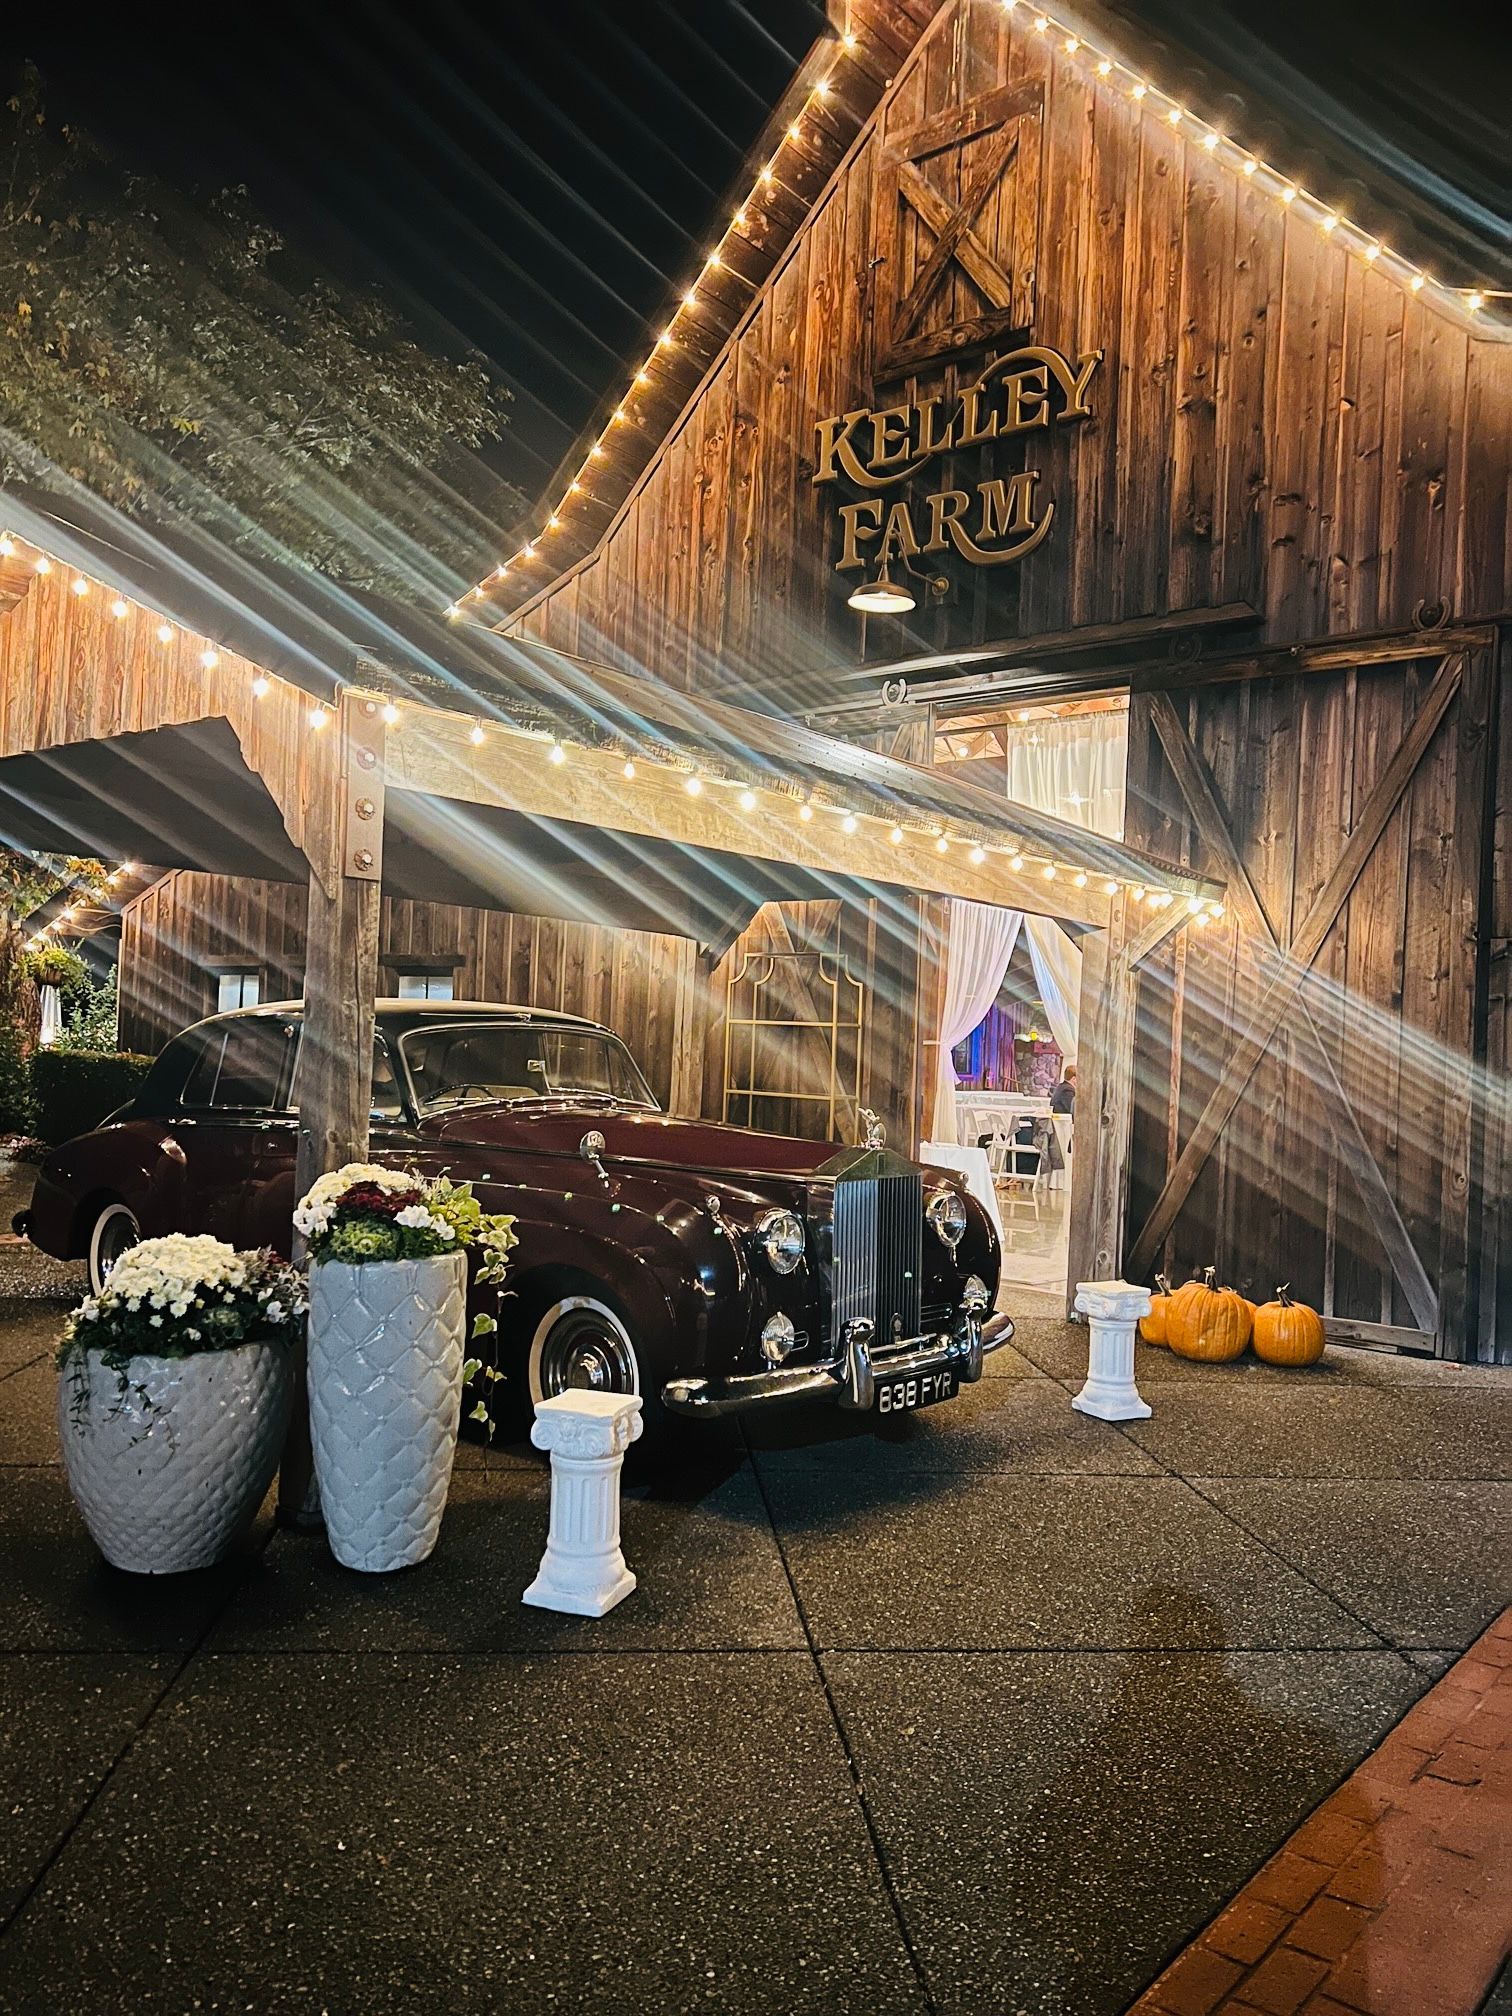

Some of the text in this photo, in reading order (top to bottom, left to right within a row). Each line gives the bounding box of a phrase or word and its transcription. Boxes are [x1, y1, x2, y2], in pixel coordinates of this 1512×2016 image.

[812, 346, 1102, 488] KELLEY
[835, 470, 1055, 571] FARM
[921, 1371, 952, 1404] FYR
